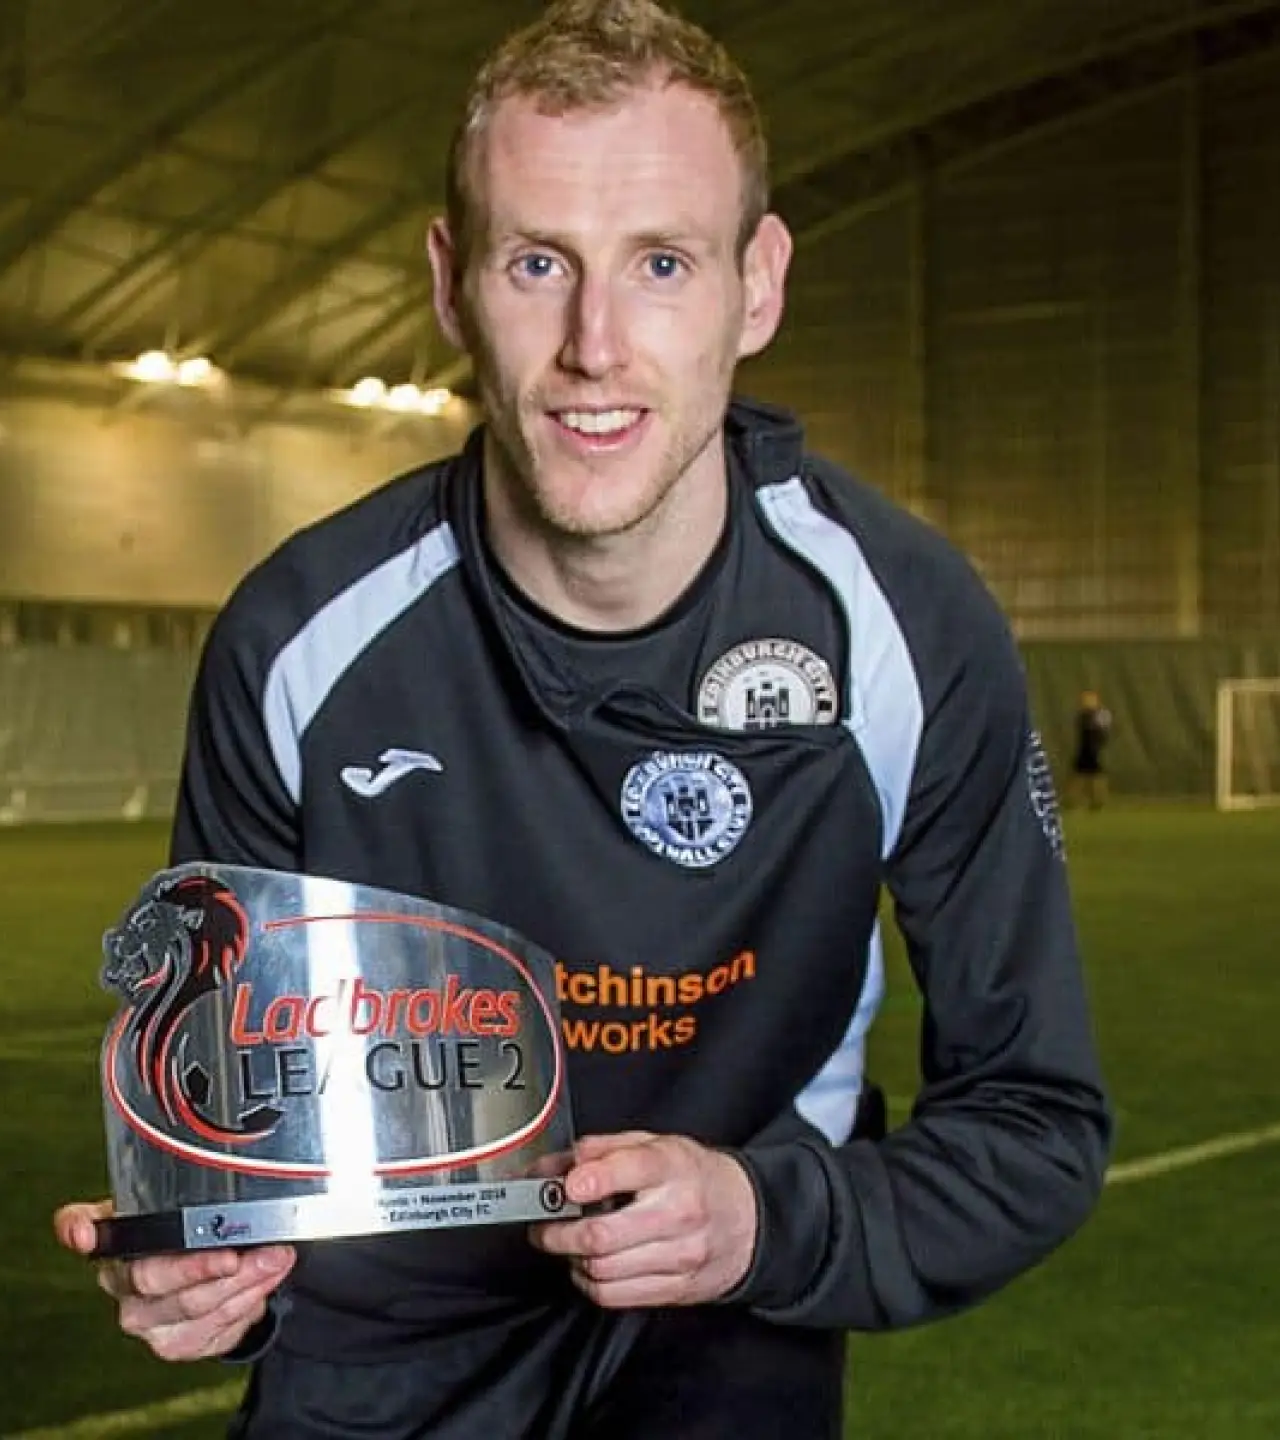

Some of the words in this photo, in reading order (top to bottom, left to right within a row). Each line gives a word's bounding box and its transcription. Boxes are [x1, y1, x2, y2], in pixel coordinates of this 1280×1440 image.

[554, 949, 757, 1007] tchinson
[561, 1012, 697, 1055] works
[500, 1041, 527, 1091] 2
